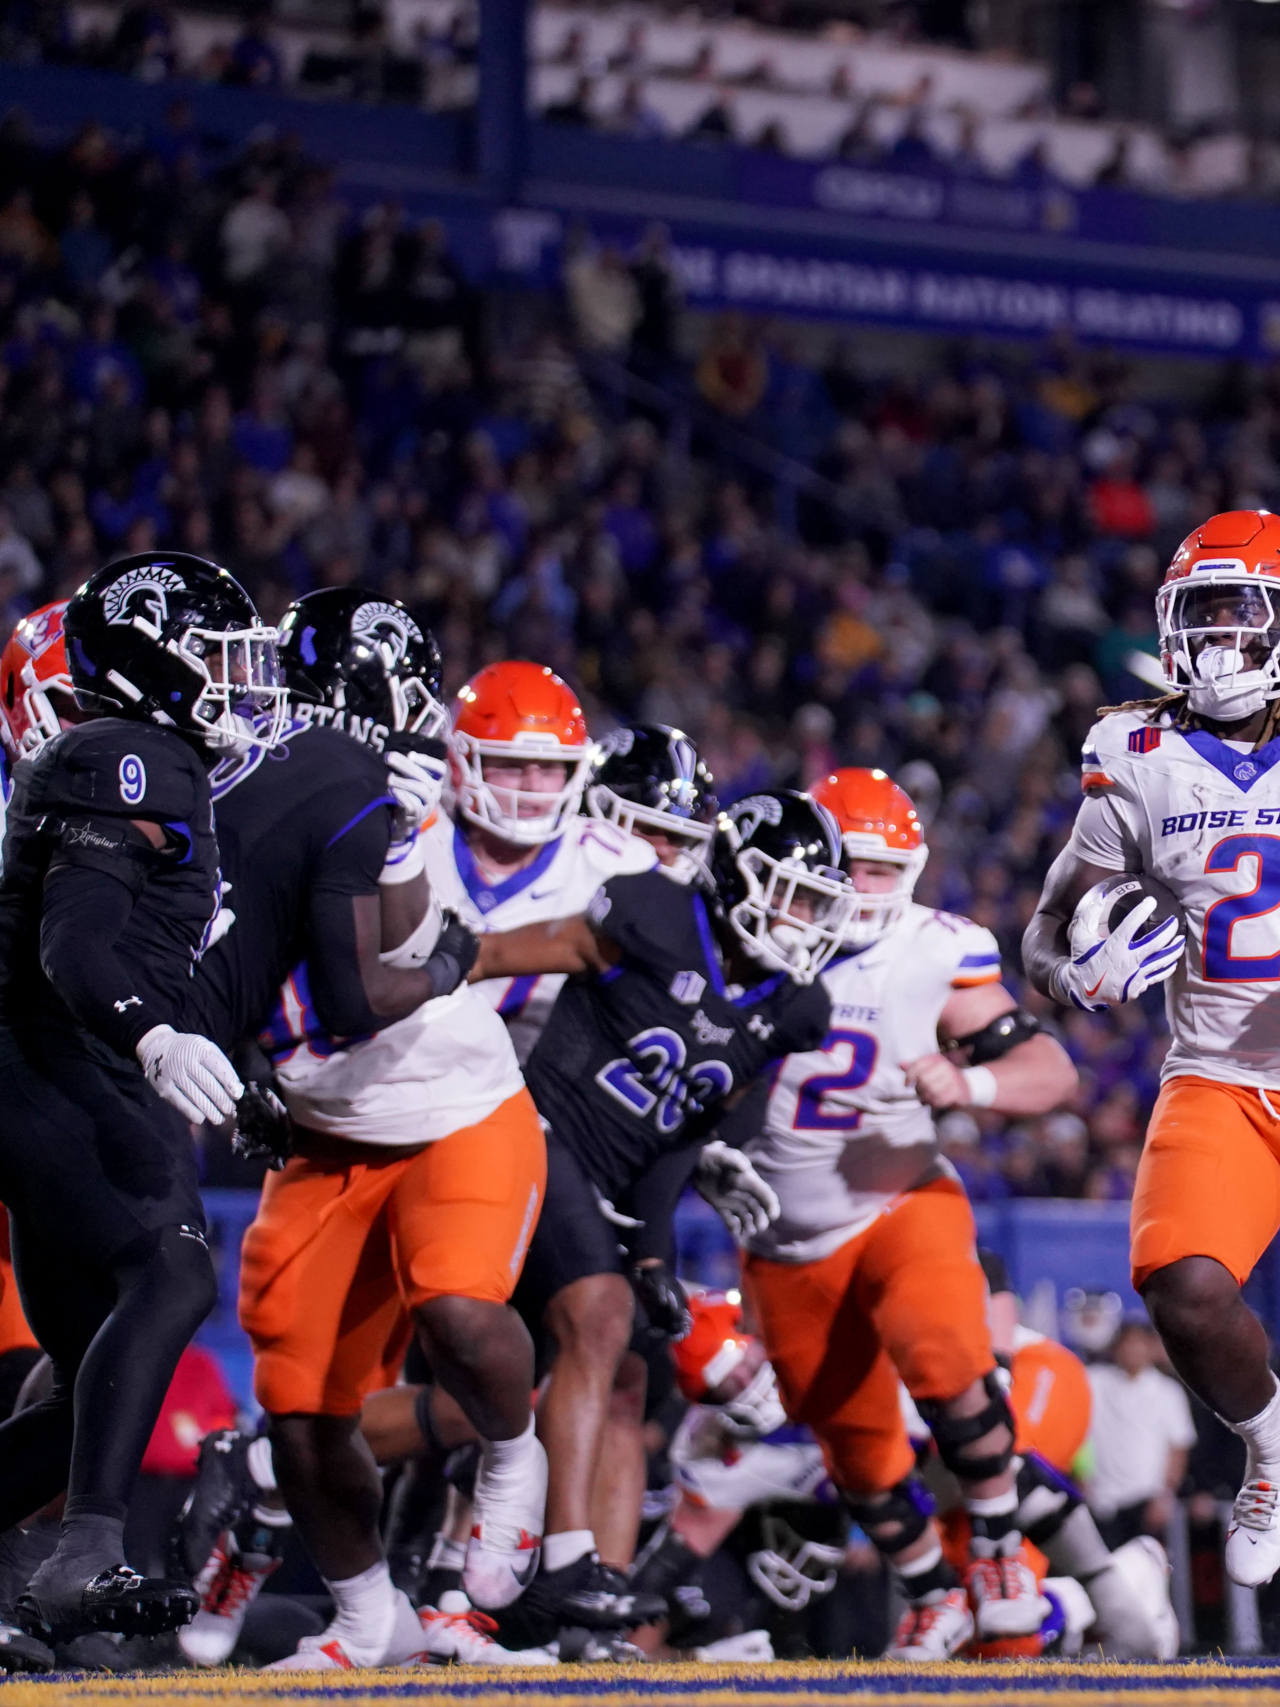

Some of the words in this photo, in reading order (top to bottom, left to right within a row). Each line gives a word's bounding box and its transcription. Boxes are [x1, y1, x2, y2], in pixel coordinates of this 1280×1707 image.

[119, 754, 146, 805] 9
[80, 830, 115, 849] Douglas
[1161, 810, 1249, 837] BOISE
[768, 1025, 879, 1131] 2
